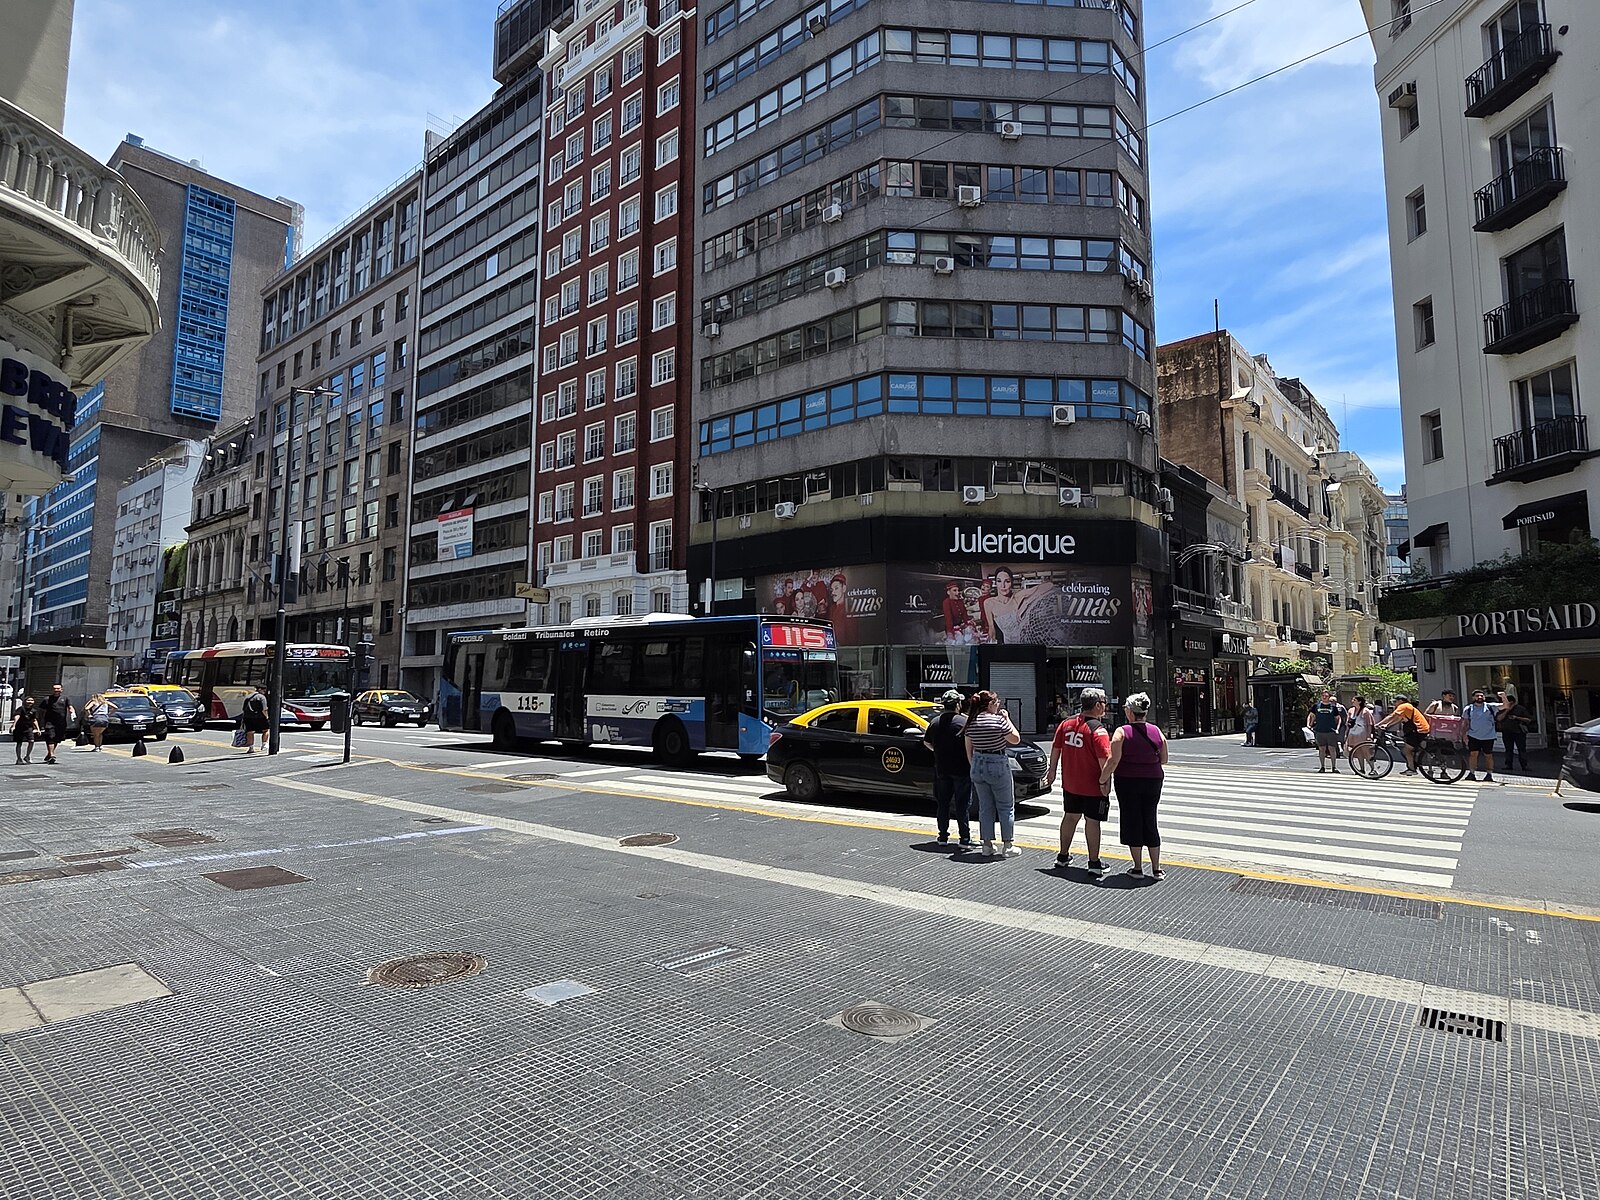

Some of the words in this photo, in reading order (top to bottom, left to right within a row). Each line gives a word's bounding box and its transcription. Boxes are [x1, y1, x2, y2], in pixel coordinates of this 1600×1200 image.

[1516, 511, 1555, 527] PORTSAID
[949, 526, 1076, 561] Juleriaque
[847, 588, 877, 596] celebrating
[1061, 582, 1111, 596] celebrating
[1457, 602, 1596, 637] PORTSAID
[502, 633, 527, 641] Soldati
[535, 631, 575, 639] Tribunales
[584, 629, 610, 637] Retiro
[781, 626, 825, 647] 115
[517, 696, 539, 711] 115
[1064, 731, 1084, 748] 16
